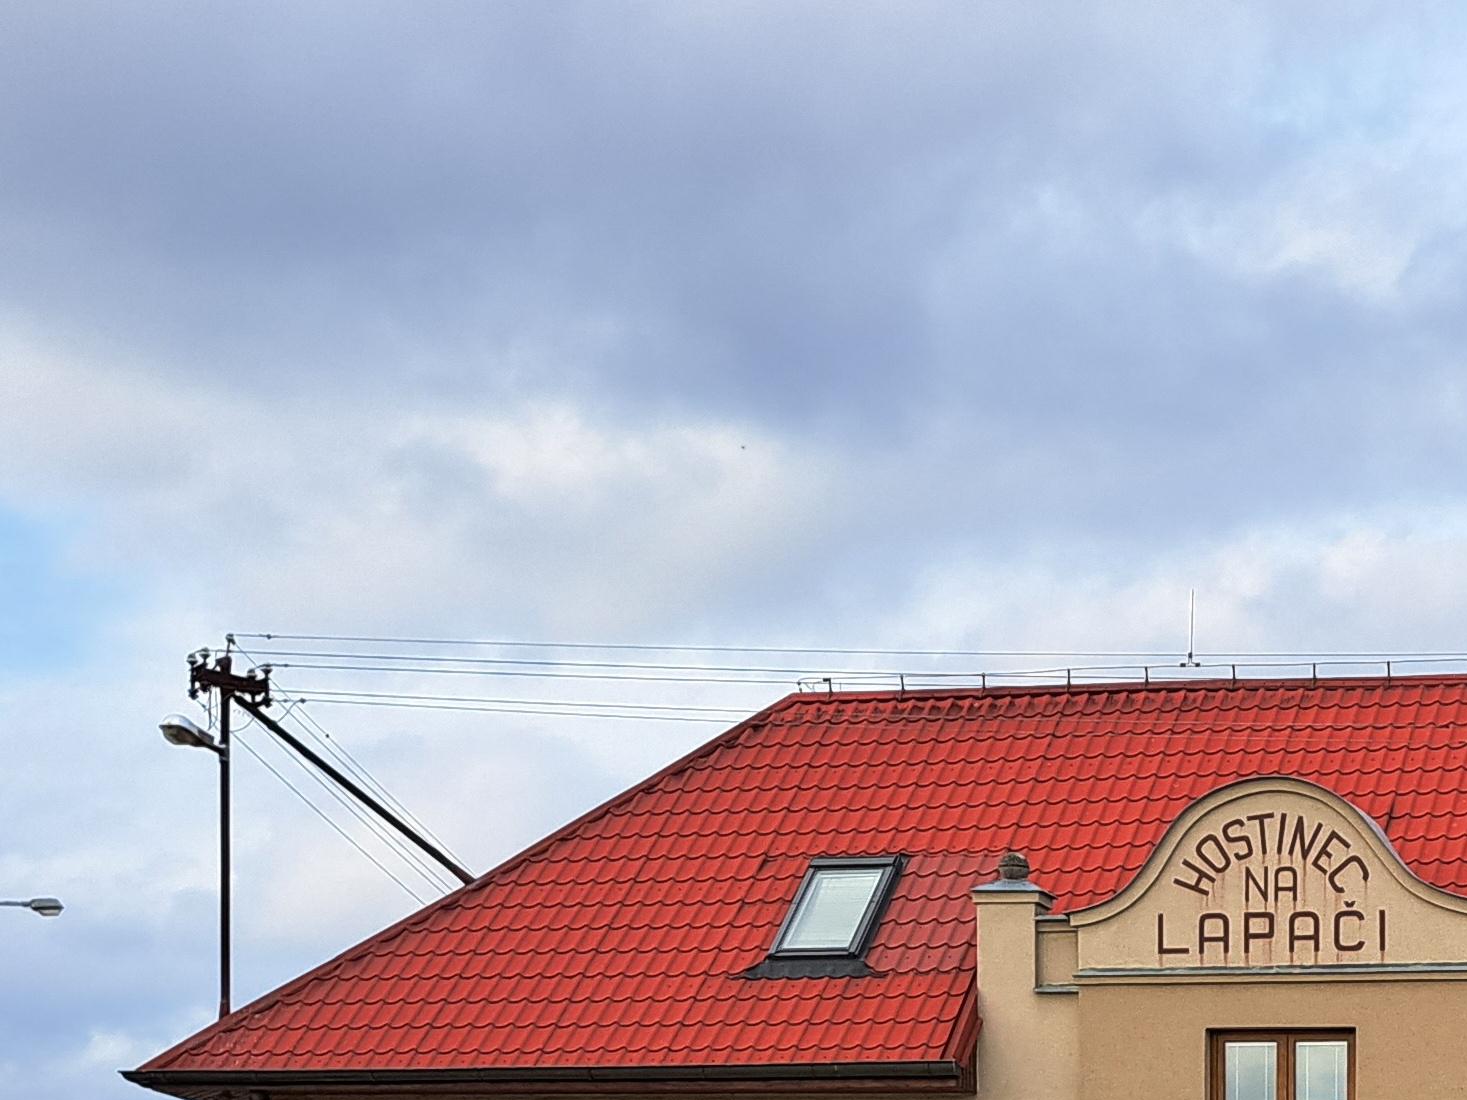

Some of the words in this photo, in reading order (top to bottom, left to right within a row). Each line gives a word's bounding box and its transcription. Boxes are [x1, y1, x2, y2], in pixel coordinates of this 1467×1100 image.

[1173, 812, 1370, 896] HOSTINEC
[1245, 866, 1298, 902] NA
[1157, 900, 1386, 954] LAPAČI
